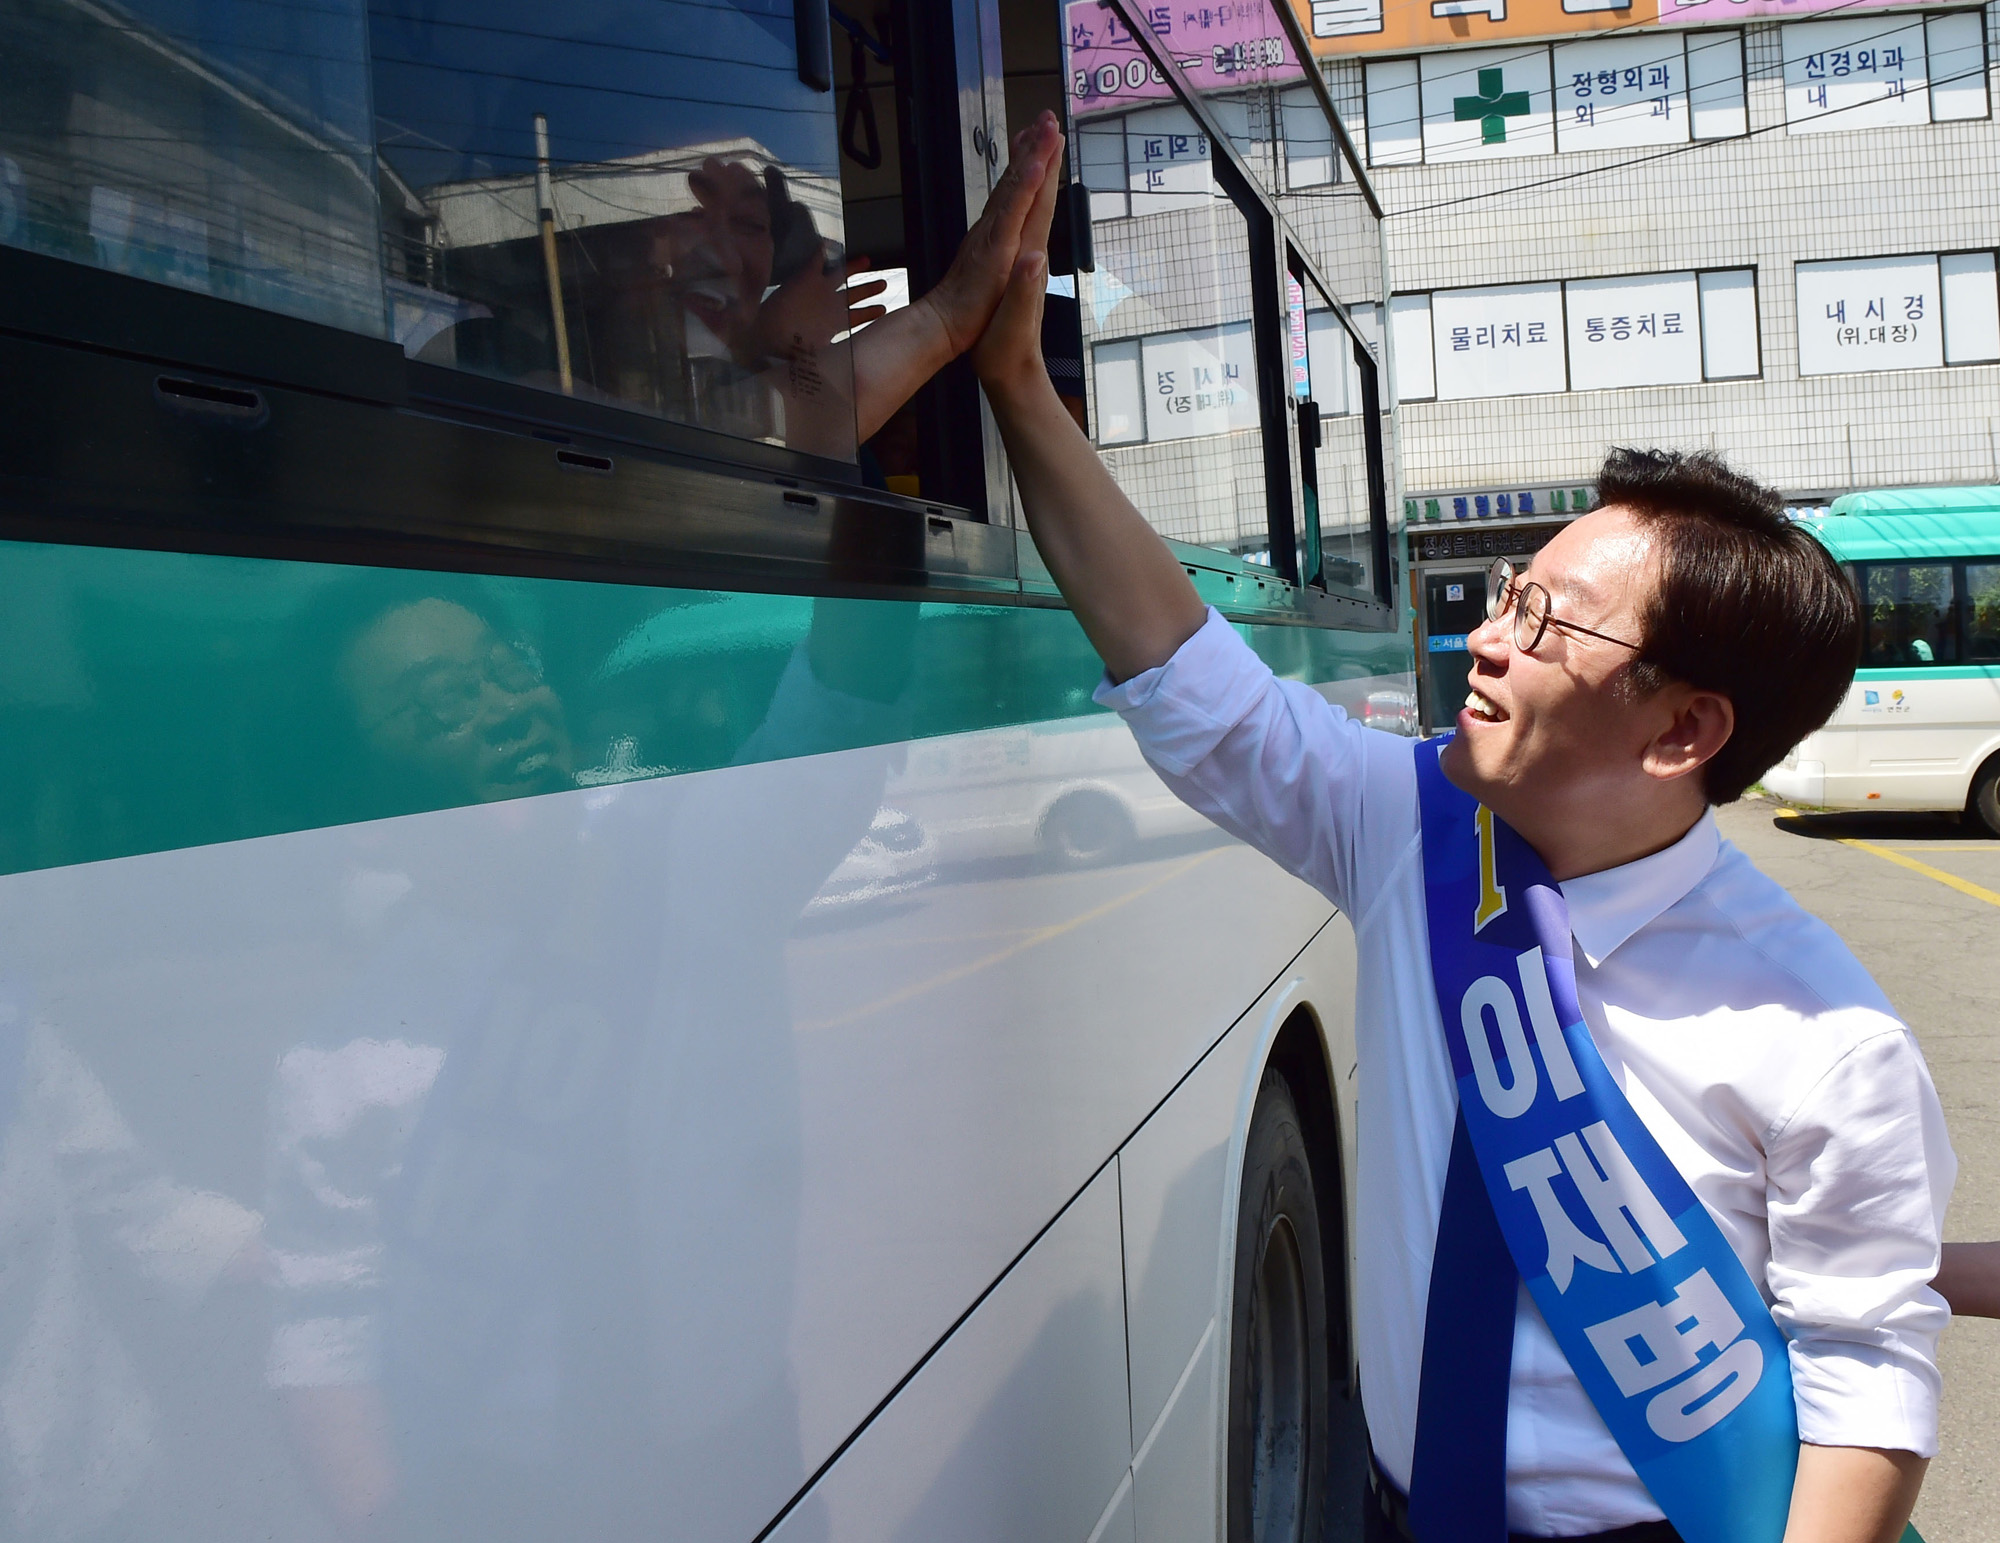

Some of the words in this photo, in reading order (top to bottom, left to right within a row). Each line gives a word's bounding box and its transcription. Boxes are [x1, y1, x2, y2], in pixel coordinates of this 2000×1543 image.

[1805, 46, 1904, 79] 신경외과
[1572, 65, 1669, 97] 정형외과
[1450, 321, 1548, 351] 물리치료
[1584, 312, 1684, 343] 통증치료
[1836, 323, 1917, 346] (위.대장)
[1474, 802, 1508, 936] 1
[1460, 945, 1763, 1443] 이재명
